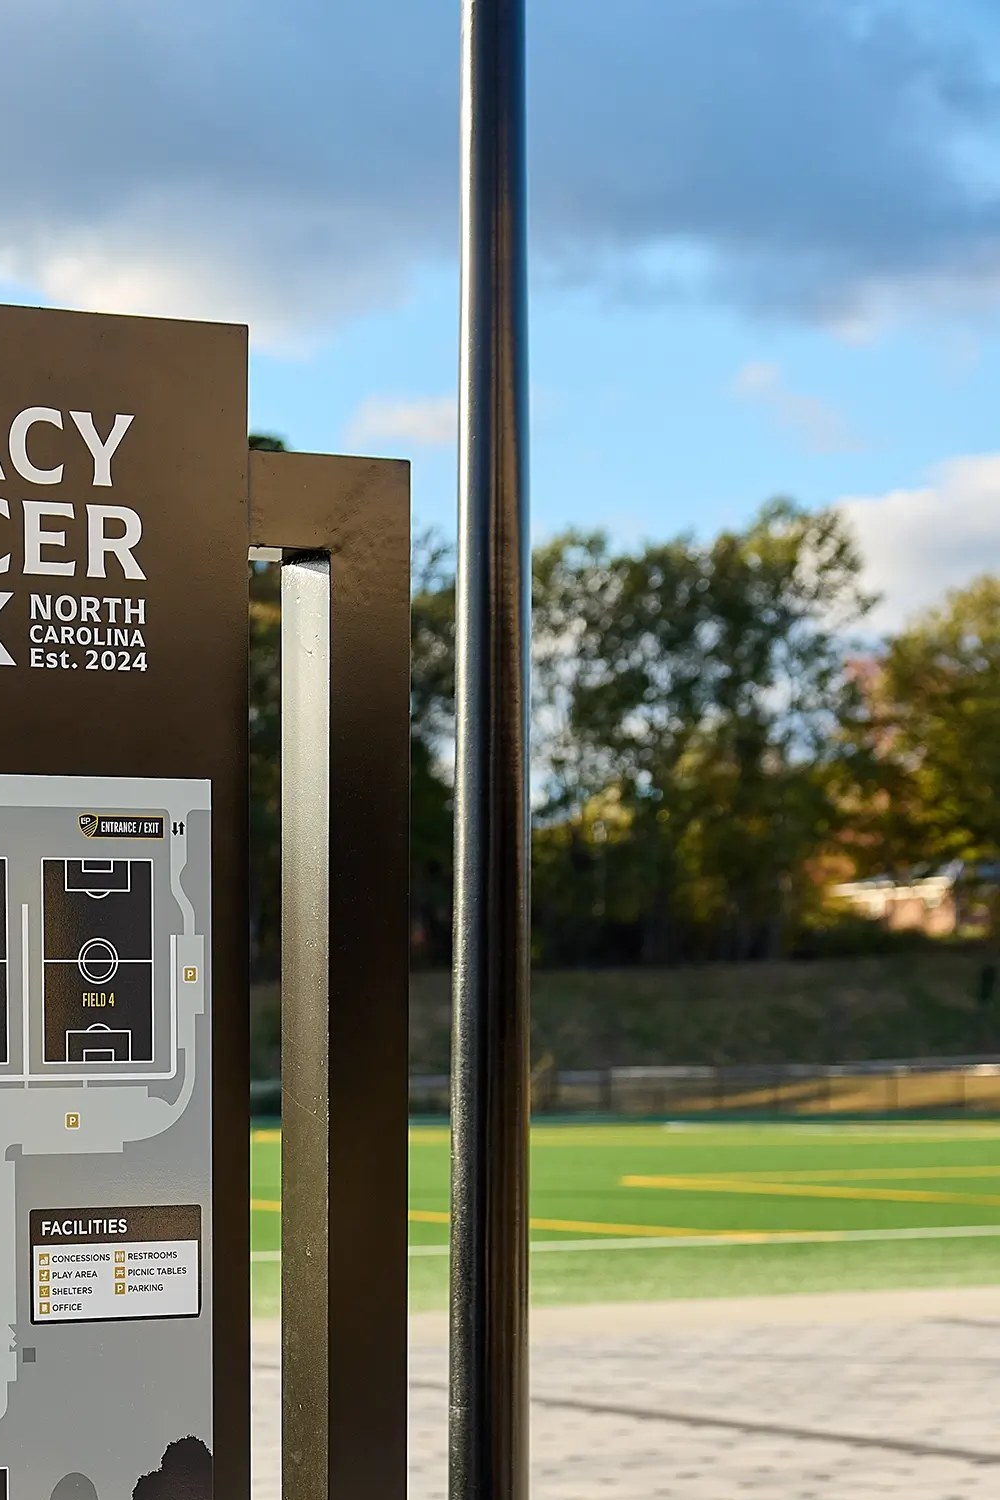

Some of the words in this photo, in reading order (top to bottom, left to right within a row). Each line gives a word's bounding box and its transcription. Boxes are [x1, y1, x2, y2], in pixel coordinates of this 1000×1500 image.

[30, 593, 146, 625] NORTH
[29, 624, 146, 648] CAROLINA
[30, 647, 78, 669] Est.
[85, 649, 148, 672] 2024
[100, 820, 137, 834] ENTRANCE
[143, 822, 160, 835] EXIT
[186, 969, 194, 979] P
[82, 992, 106, 1007] FIELD
[107, 992, 115, 1007] 4
[69, 1115, 77, 1126] P
[41, 1218, 128, 1236] FACILITIES
[51, 1253, 111, 1263] CONCESSIONS
[127, 1251, 178, 1261] RESTROOMS
[52, 1271, 73, 1280] PLAY
[74, 1270, 98, 1279] AREA
[127, 1268, 155, 1277] PICNIC
[156, 1266, 187, 1276] TABLES
[51, 1286, 93, 1296] SHELTERS
[127, 1284, 164, 1293] PARKING
[52, 1303, 83, 1312] OFFICE
